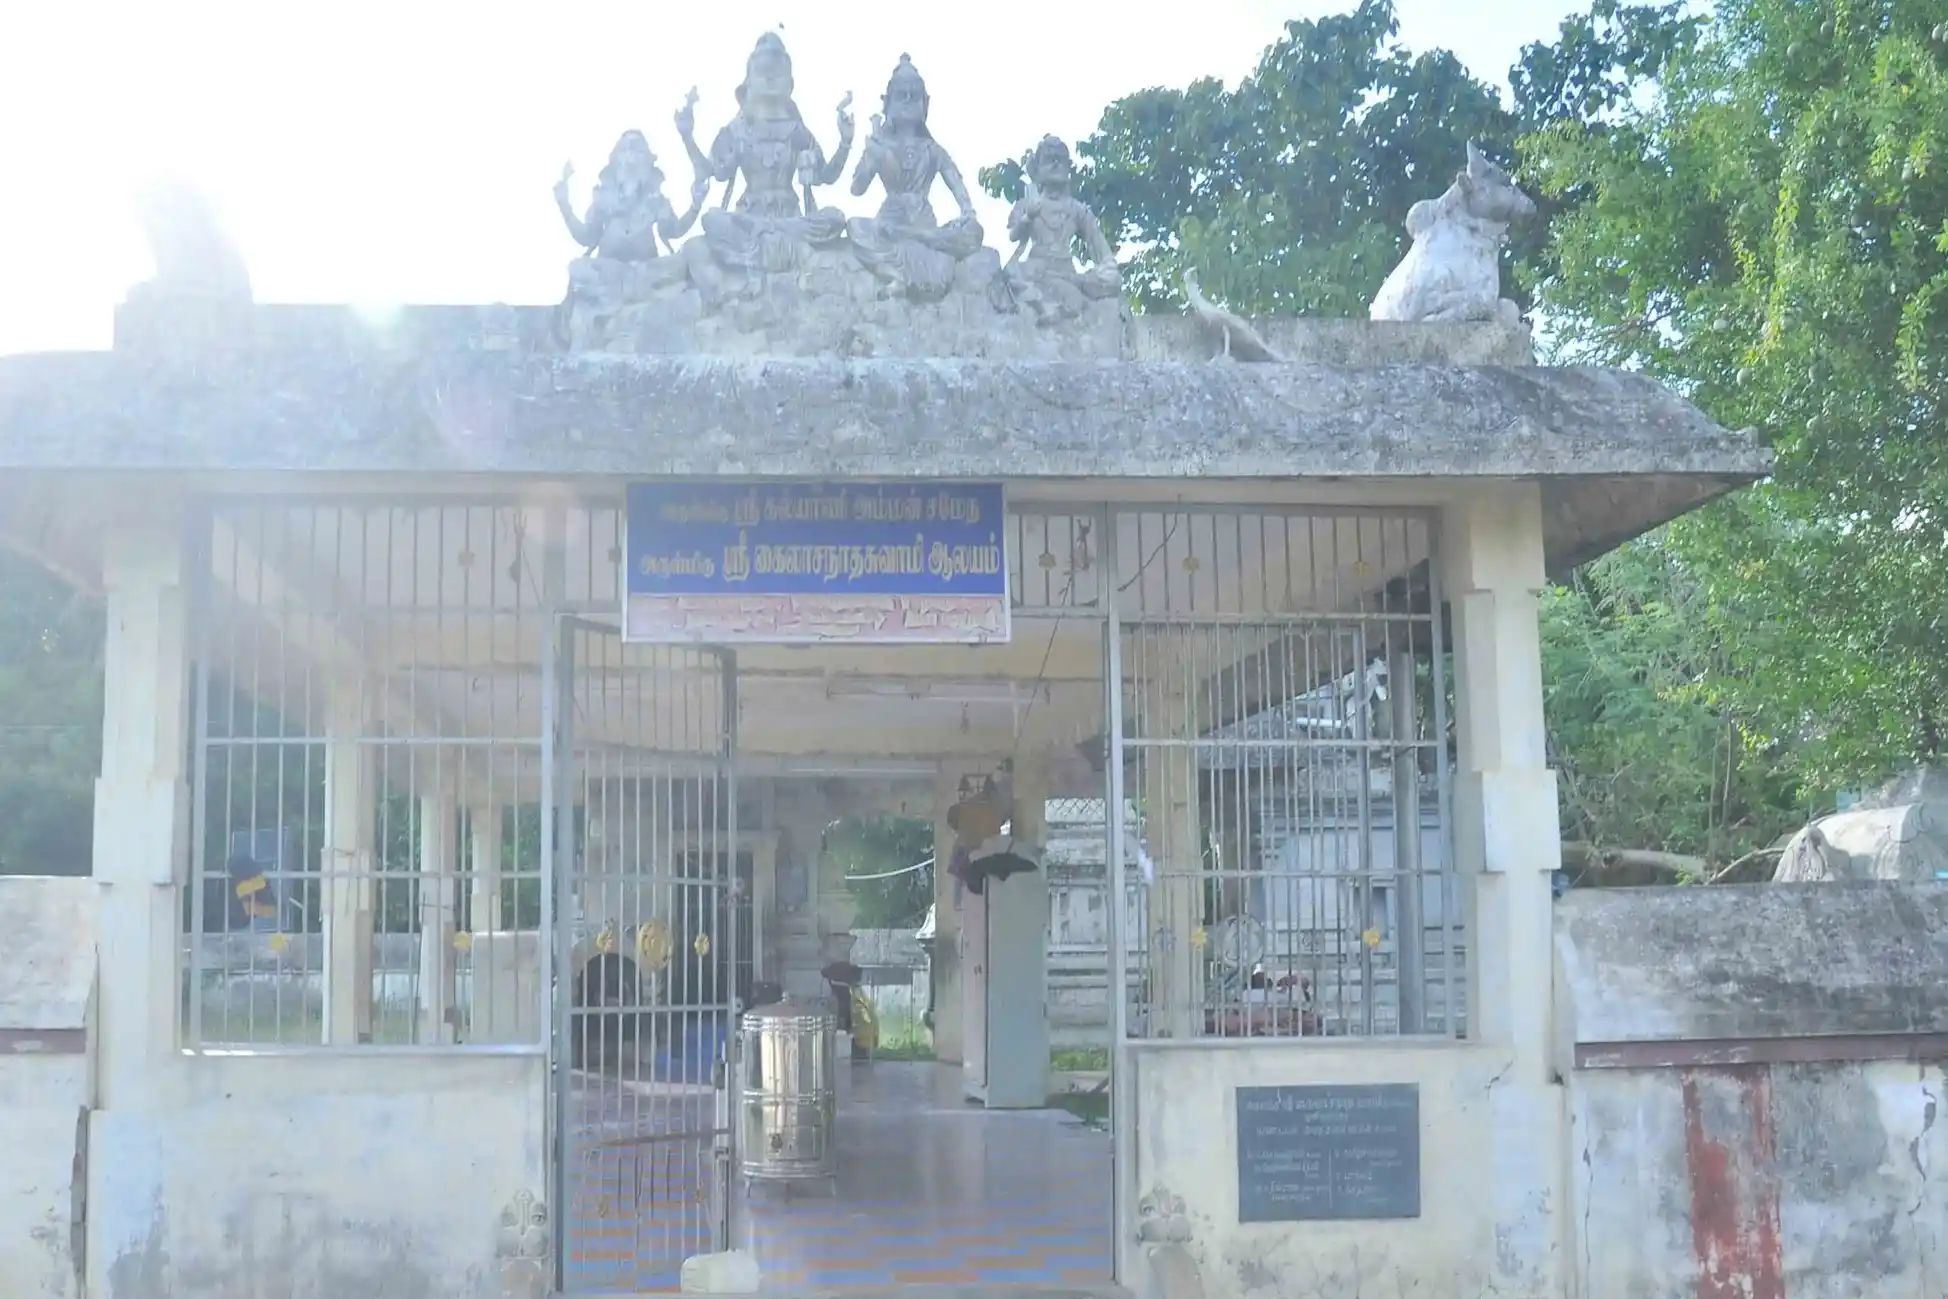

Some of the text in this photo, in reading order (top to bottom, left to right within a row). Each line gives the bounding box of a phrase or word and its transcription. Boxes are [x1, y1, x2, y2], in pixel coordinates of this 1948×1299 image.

[853, 485, 923, 522] அம்மன்
[724, 527, 751, 582] ஸ்ரீ
[926, 533, 1000, 581] ஆலயம்
